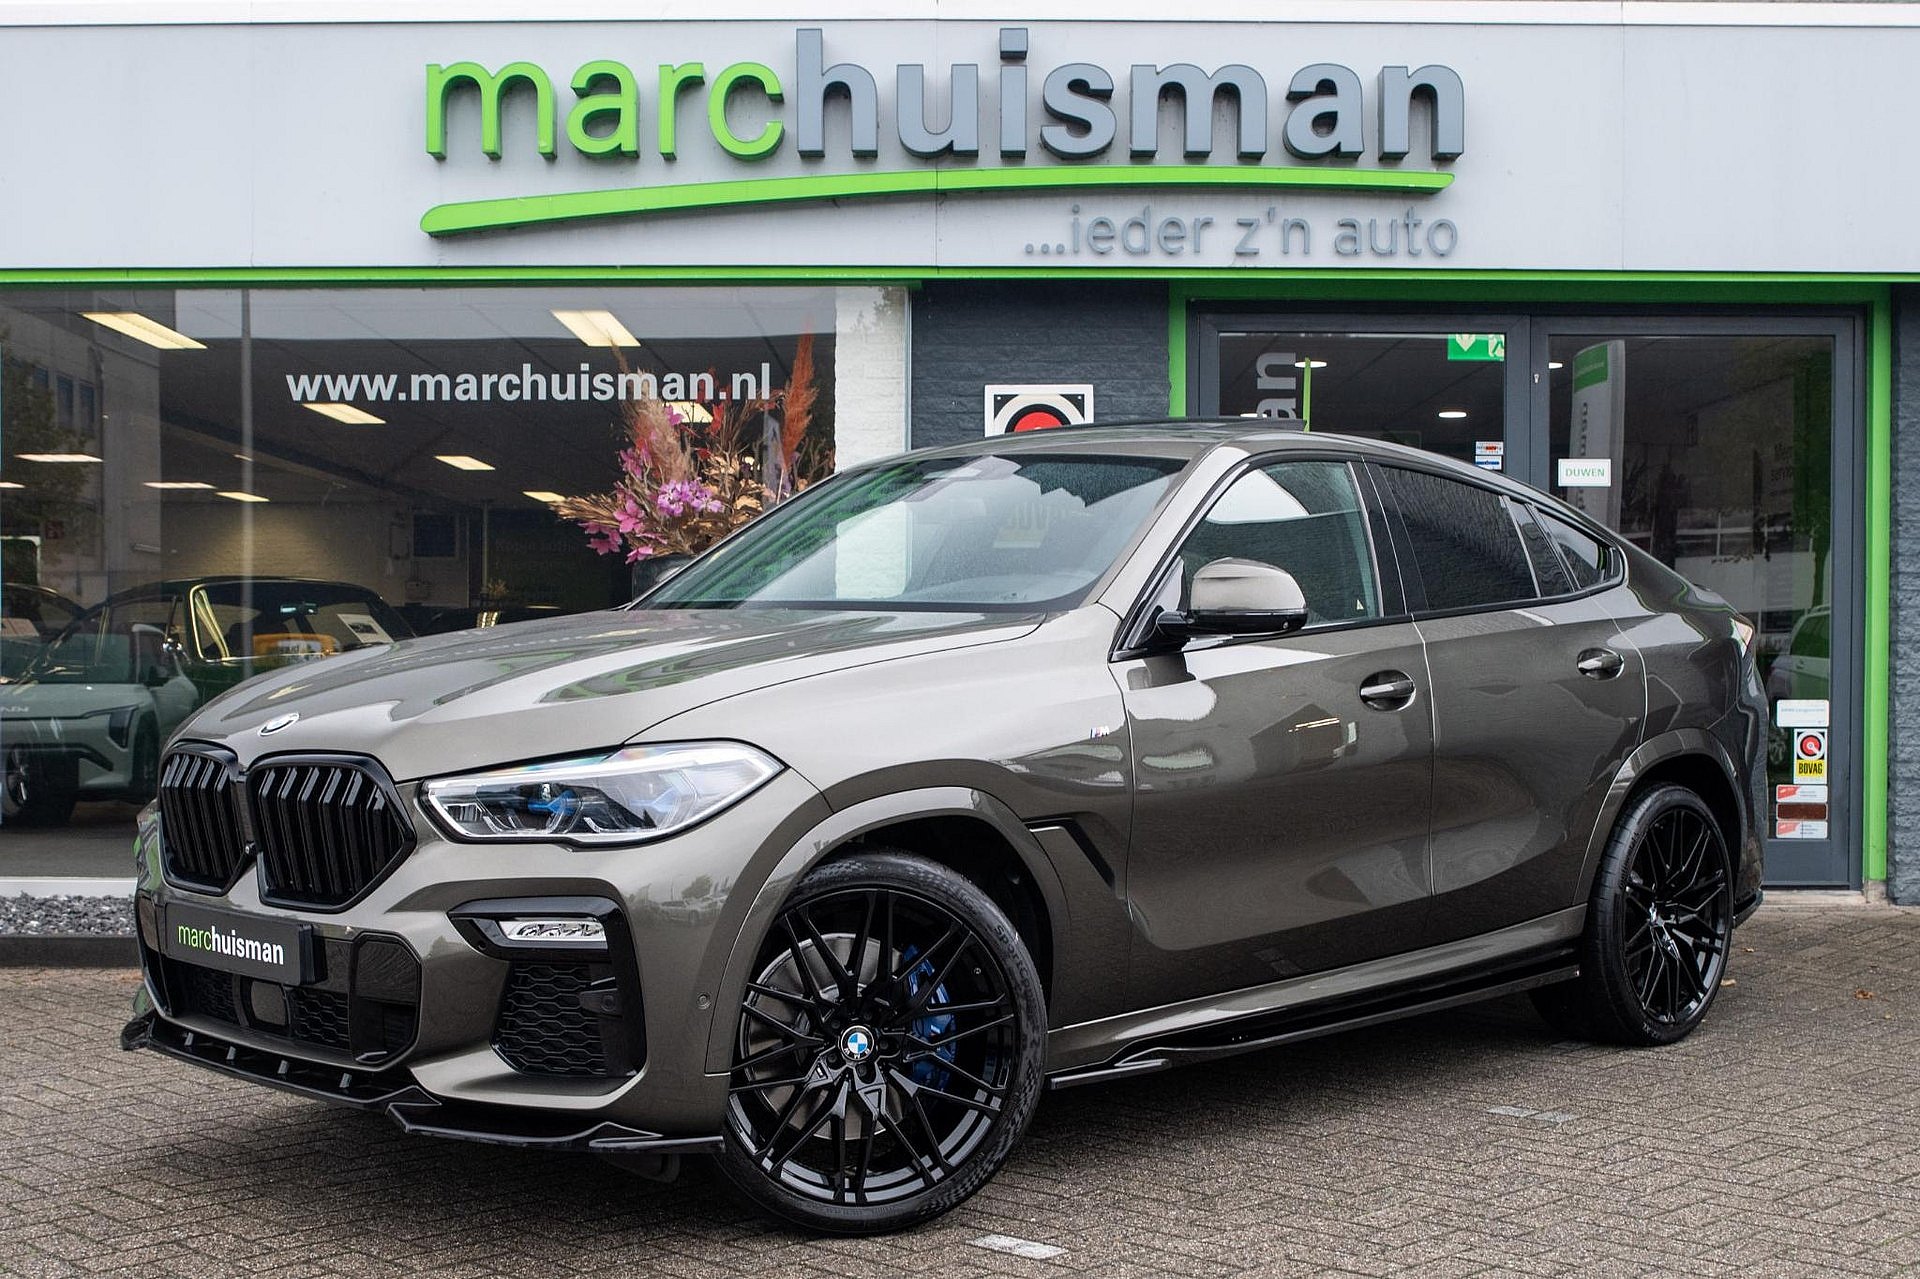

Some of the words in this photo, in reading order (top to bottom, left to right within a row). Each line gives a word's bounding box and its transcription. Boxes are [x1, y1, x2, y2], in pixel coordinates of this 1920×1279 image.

[425, 27, 1465, 162] marchuisman
[1234, 206, 1311, 257] z'n
[1334, 206, 1459, 258] auto
[285, 362, 770, 402] www.marchuisman.nl
[1565, 467, 1605, 478] DUWEN
[1798, 762, 1823, 775] BOVAG
[178, 924, 284, 966] marchuisman
